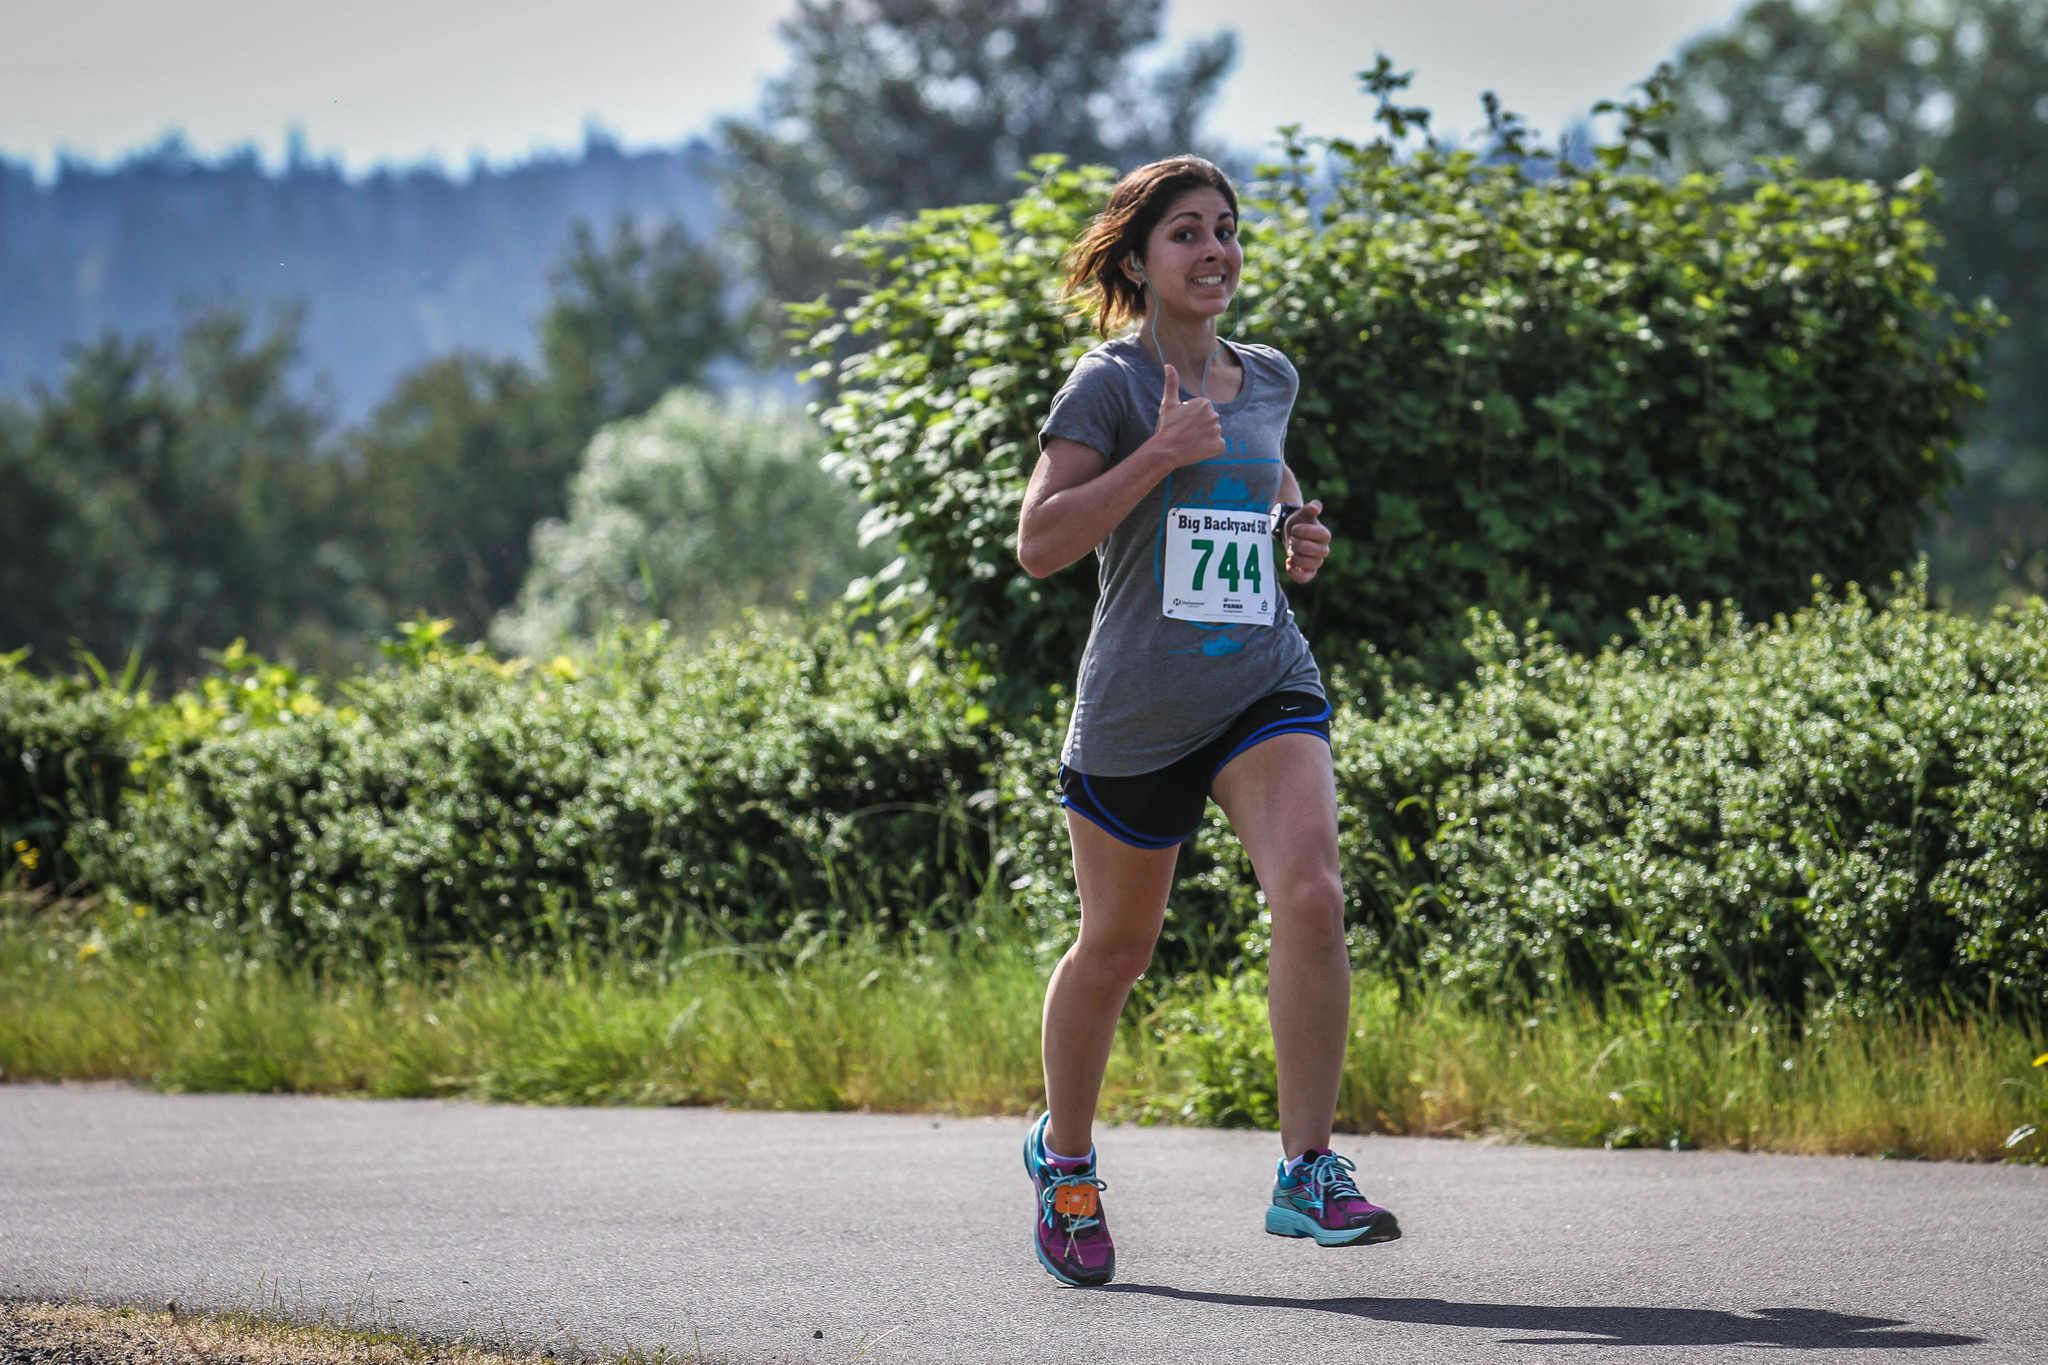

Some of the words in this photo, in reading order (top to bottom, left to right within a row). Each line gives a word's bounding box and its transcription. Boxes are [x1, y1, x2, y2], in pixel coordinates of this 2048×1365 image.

[1178, 515, 1201, 533] Big
[1203, 516, 1256, 536] Backyard
[1257, 520, 1267, 534] 5K
[1191, 539, 1262, 594] 744
